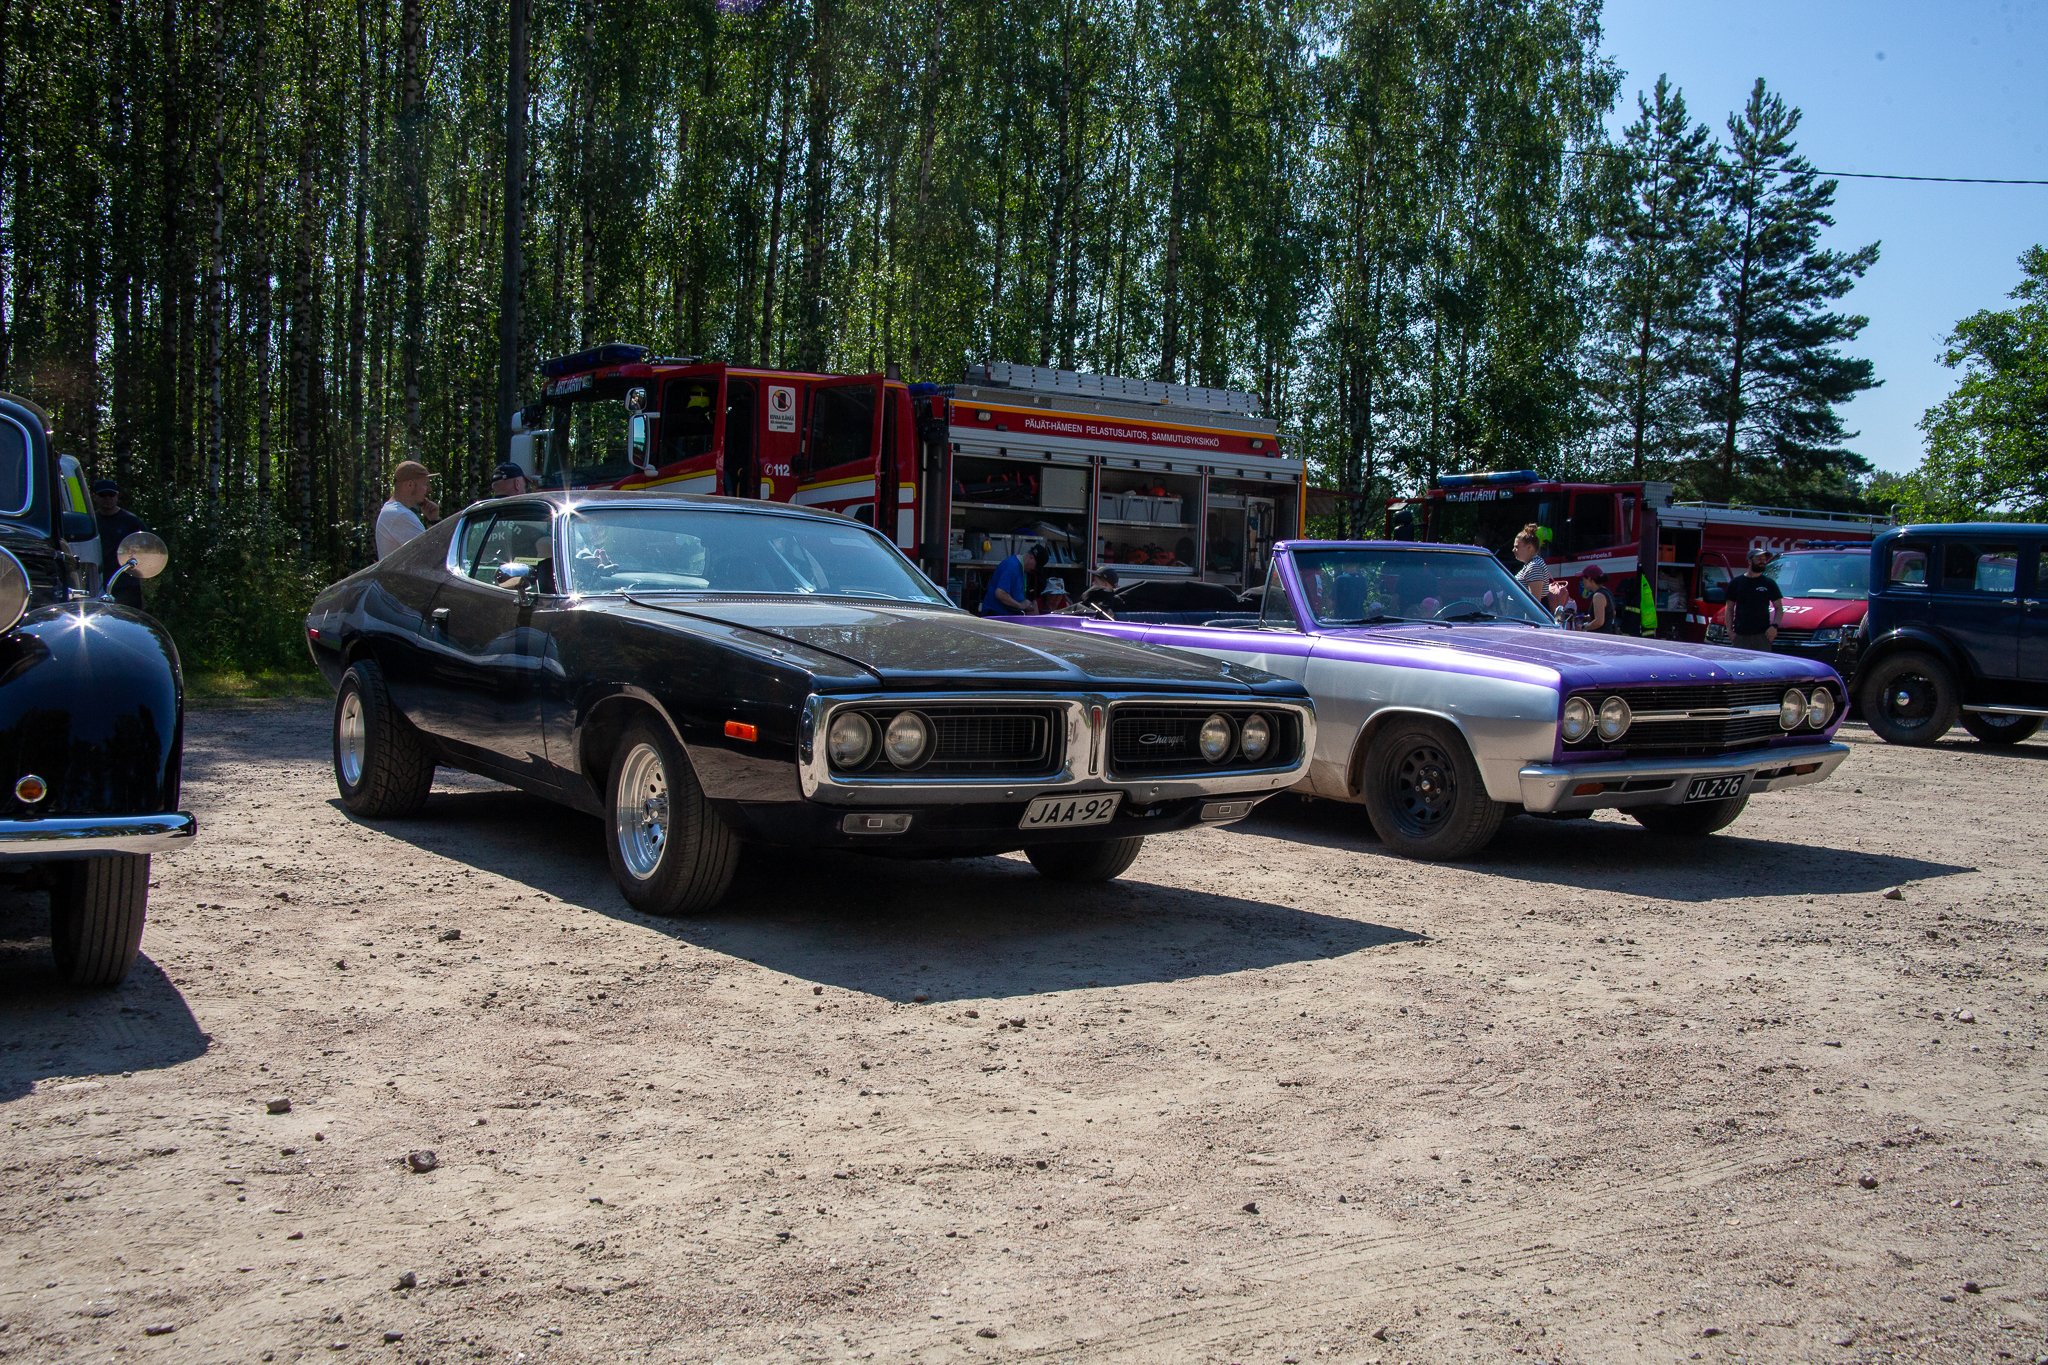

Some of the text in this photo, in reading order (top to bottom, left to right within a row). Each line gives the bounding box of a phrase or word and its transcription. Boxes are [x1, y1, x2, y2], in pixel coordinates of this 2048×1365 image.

[1025, 418, 1220, 447] PÄIJÄT-HÄMEEN PELASTUSLAITOS, SAMMUTUSYKSIKKÖ
[774, 464, 790, 477] 112
[1459, 489, 1497, 502] ARTJÄRVI
[1138, 733, 1184, 747] Charger
[1689, 777, 1742, 799] JLZ-76
[1029, 798, 1114, 824] JAA-92
